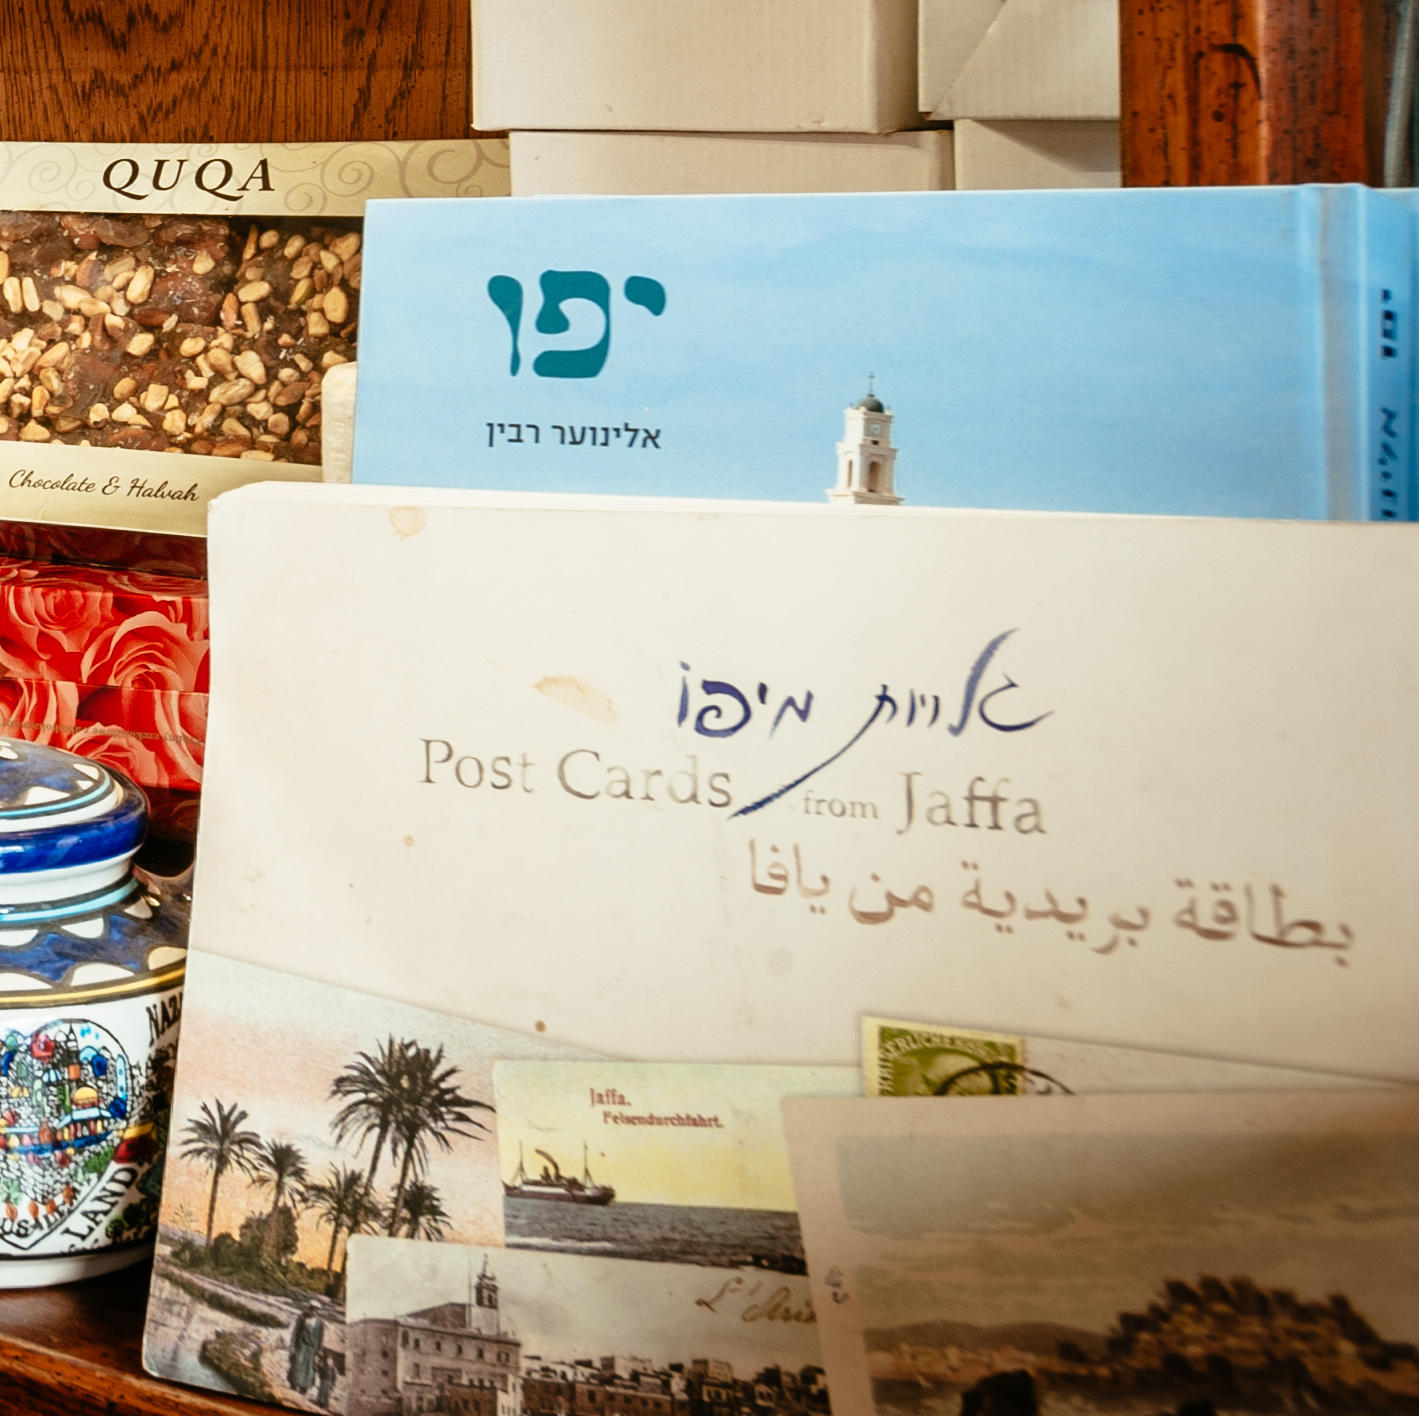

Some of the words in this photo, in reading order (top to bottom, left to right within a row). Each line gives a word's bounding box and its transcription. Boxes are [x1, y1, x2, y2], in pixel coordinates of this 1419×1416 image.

[102, 157, 276, 202] QUQA
[486, 422, 540, 450] רבין
[550, 422, 662, 451] אלינוער
[8, 468, 96, 496] Chocolate
[102, 478, 120, 496] &
[128, 478, 200, 502] Halvah
[418, 736, 536, 795] Post
[557, 747, 733, 810] Cards
[801, 786, 880, 823] from
[896, 770, 1049, 836] Jaffa
[747, 838, 833, 916] يافا
[847, 868, 935, 926] من
[960, 859, 1151, 955] بريدية
[1171, 875, 1354, 968] بطاقة
[589, 1087, 633, 1107] Jaffa.
[62, 1167, 139, 1241] LAND
